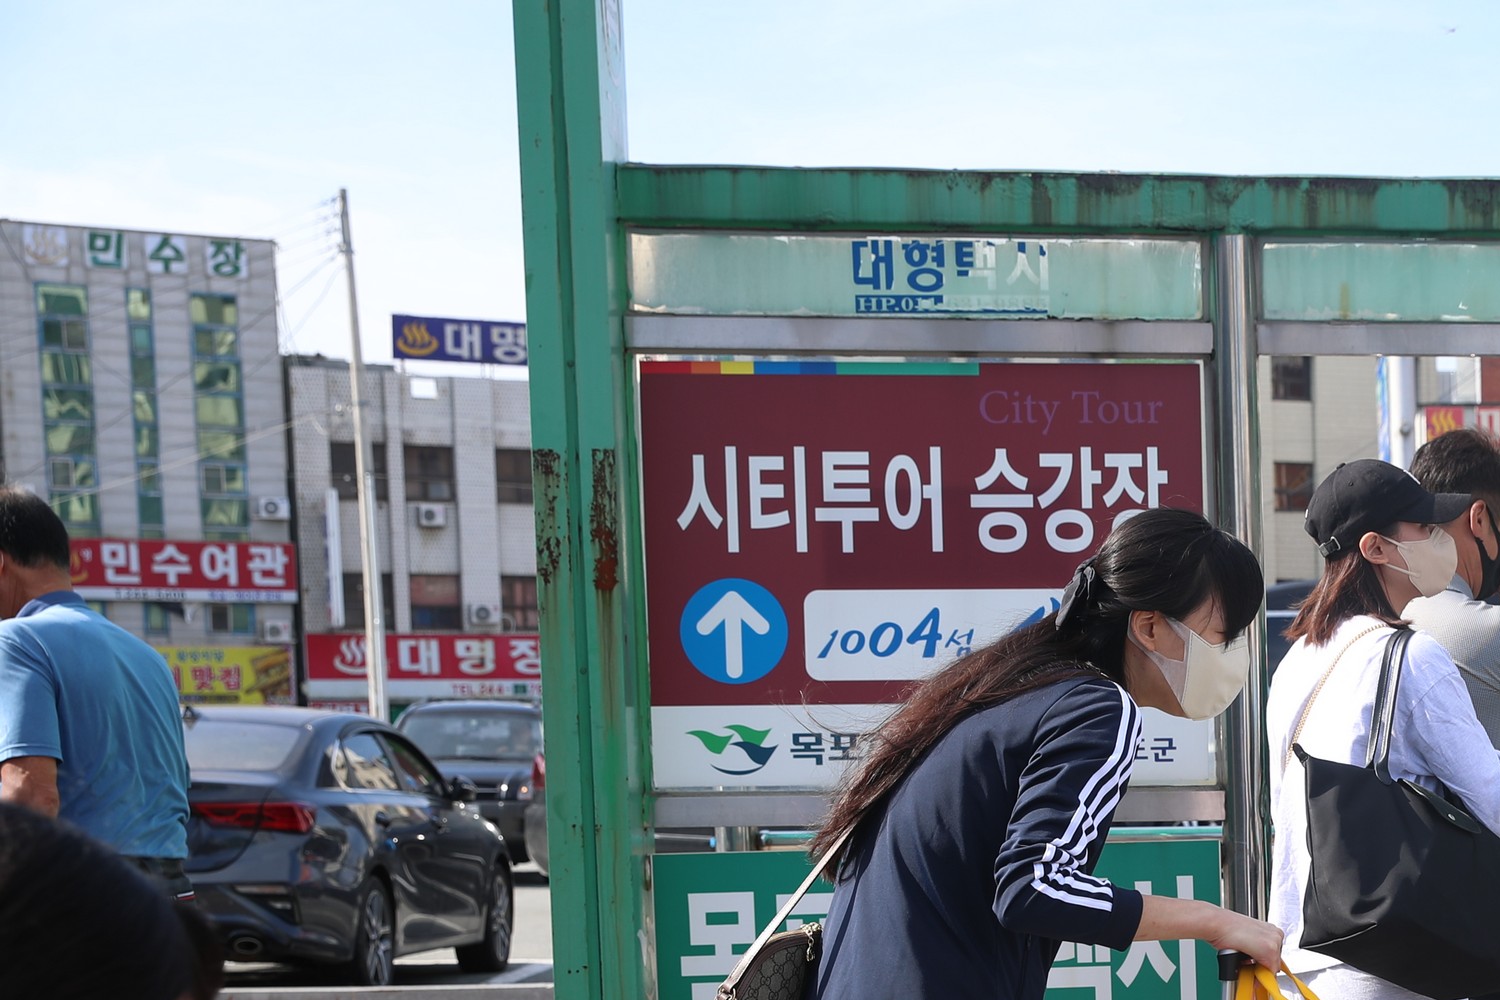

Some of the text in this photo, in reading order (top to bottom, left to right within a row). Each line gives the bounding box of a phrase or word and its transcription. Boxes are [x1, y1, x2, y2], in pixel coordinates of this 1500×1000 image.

[87, 230, 247, 279] 민수장
[978, 390, 1163, 435] City Tour
[676, 445, 1169, 554] 시티투어 승강장
[100, 541, 290, 587] 민수여관
